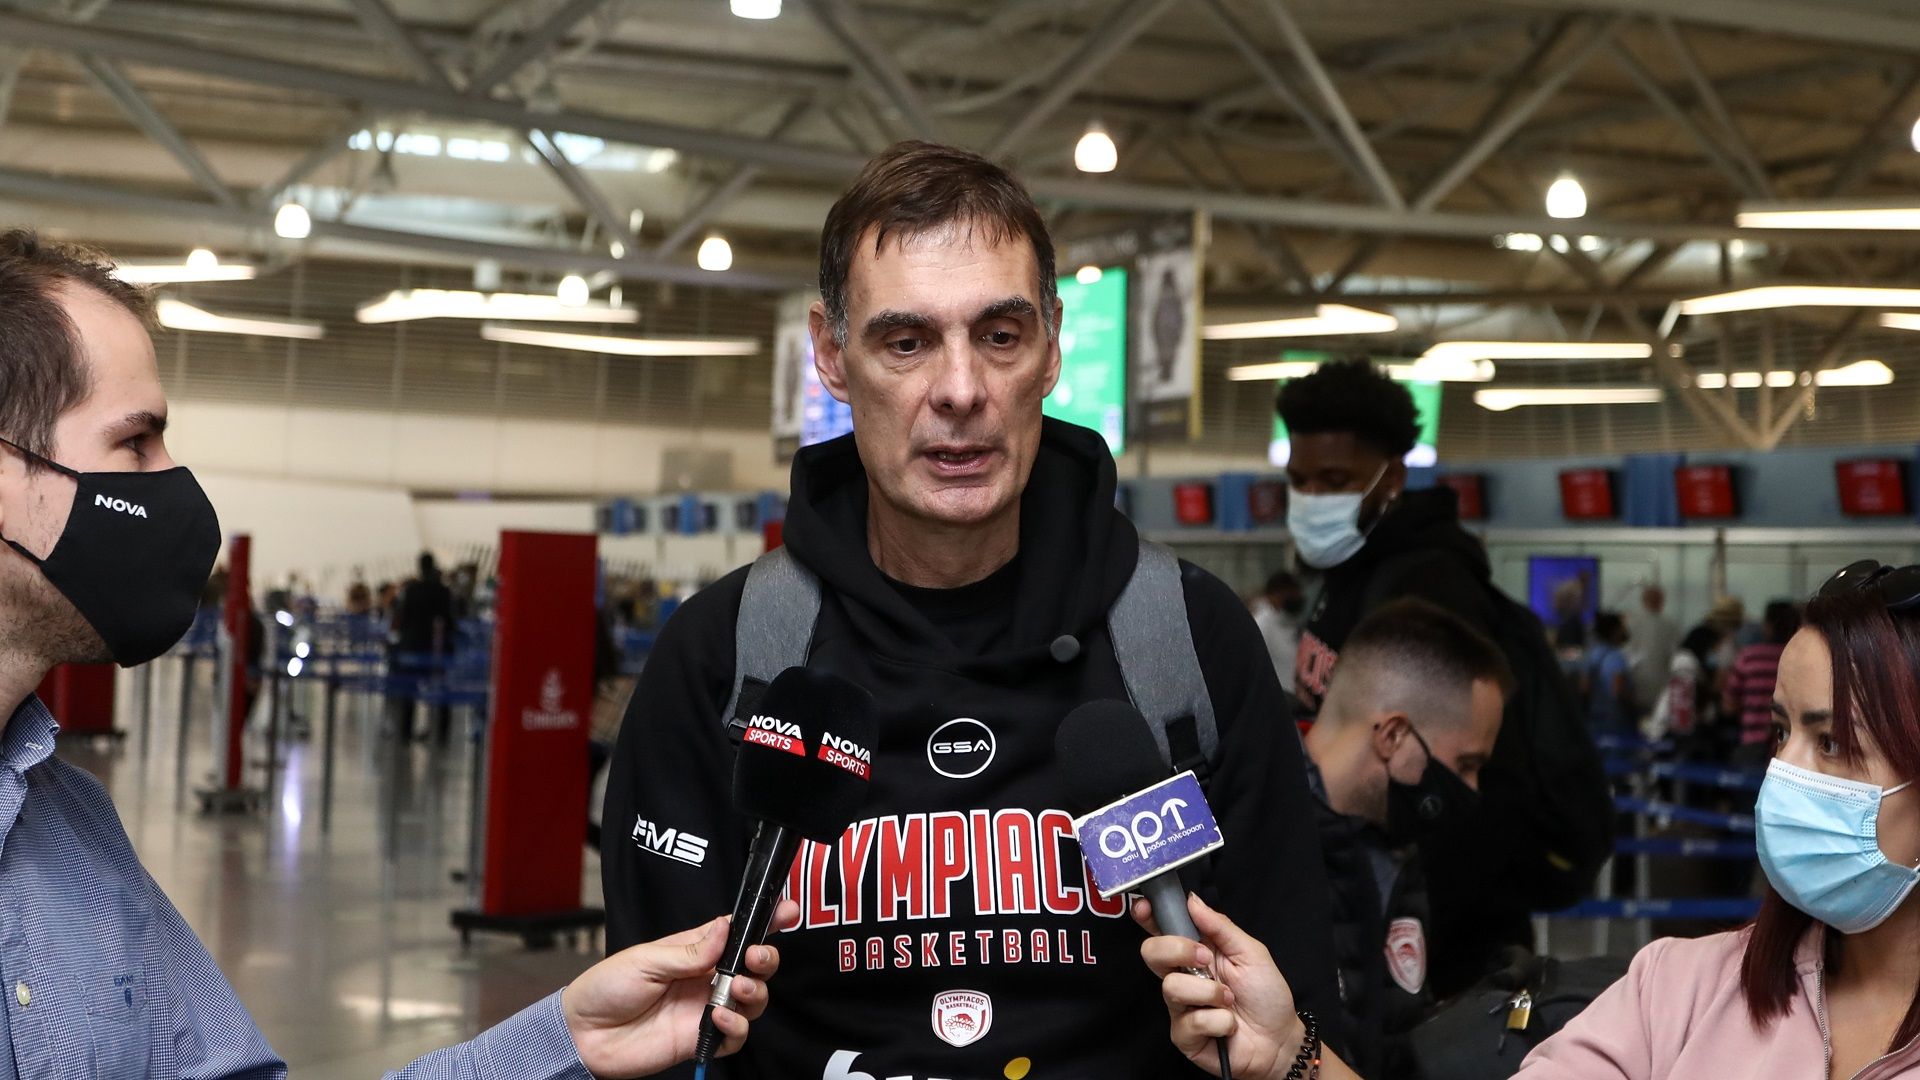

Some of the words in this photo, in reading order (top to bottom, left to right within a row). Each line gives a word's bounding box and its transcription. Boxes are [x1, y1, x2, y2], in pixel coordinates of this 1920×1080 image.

[95, 494, 148, 519] NOVA
[748, 729, 793, 750] SPORTS
[749, 714, 803, 740] NOVA
[821, 731, 872, 764] NOVA
[932, 739, 991, 754] GSA
[825, 750, 866, 776] SPORTS
[838, 929, 1097, 972] BASKETBALL
[939, 995, 985, 1006] OLYMPIACOS
[945, 1002, 979, 1011] BASKETBALL
